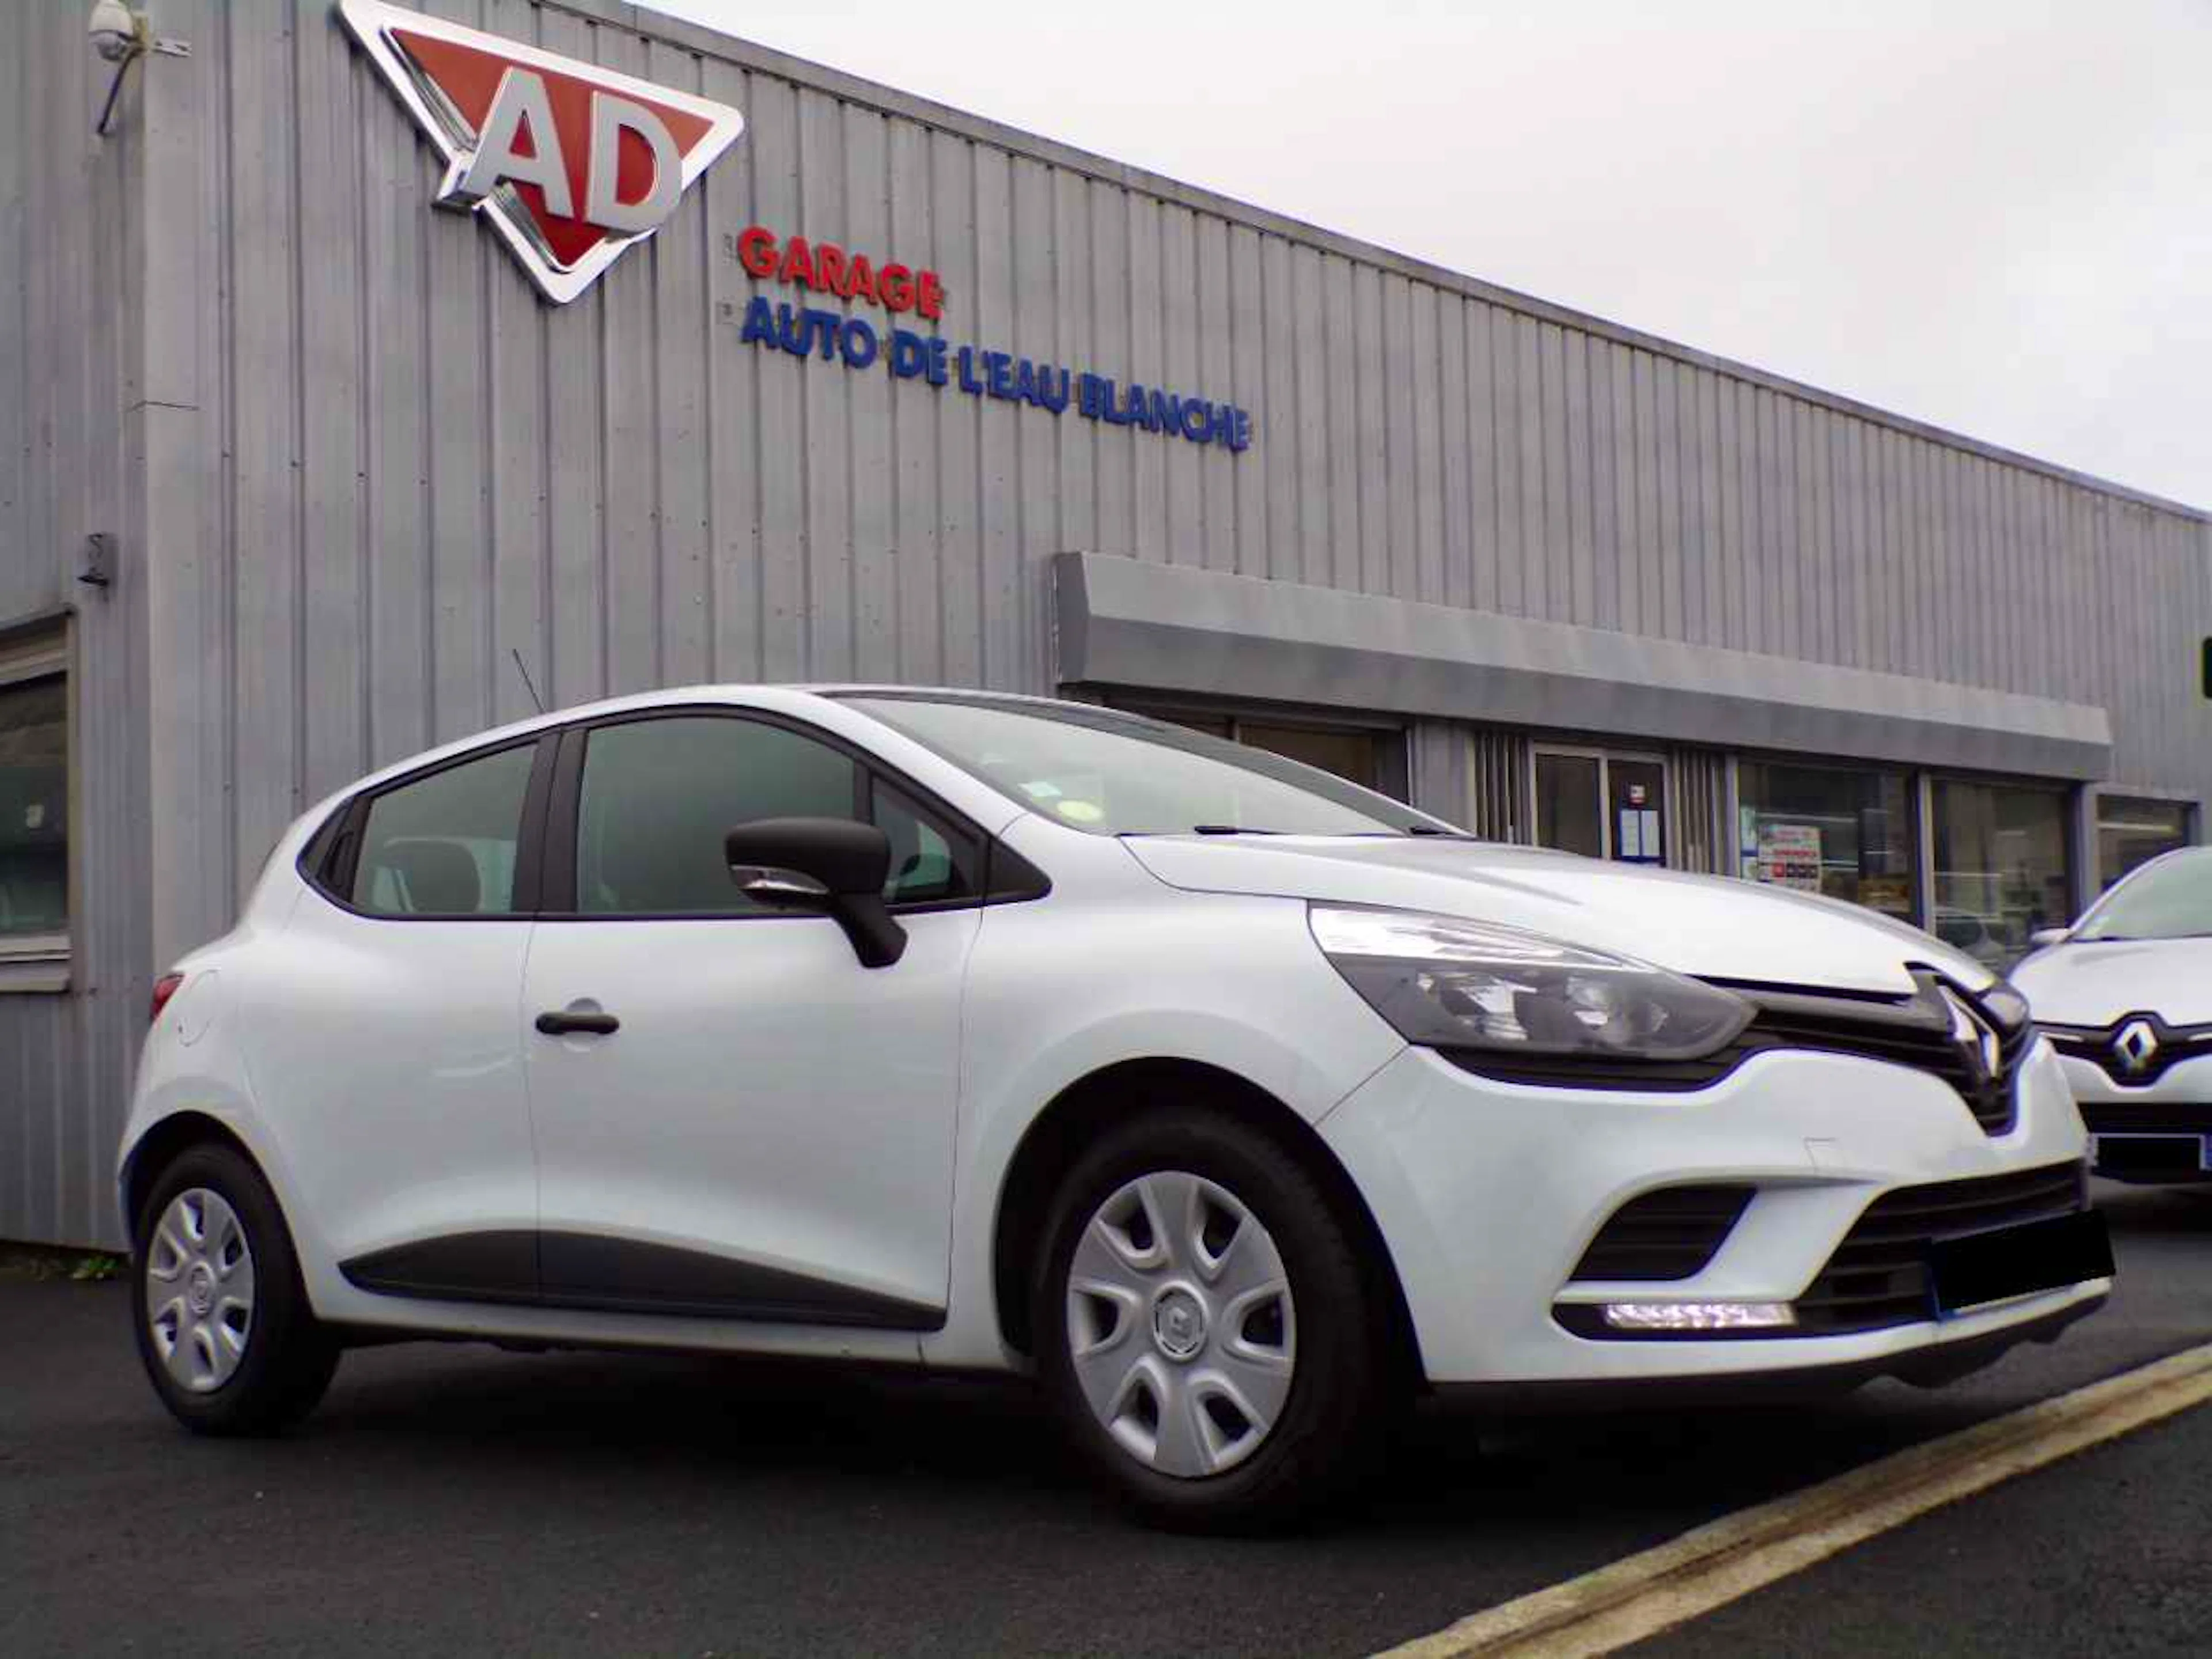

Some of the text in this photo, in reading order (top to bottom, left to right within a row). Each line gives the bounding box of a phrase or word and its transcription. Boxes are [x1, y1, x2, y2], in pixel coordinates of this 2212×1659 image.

[460, 54, 683, 233] AD
[738, 226, 945, 320] GARAGE
[741, 295, 1251, 452] AUTO DE L'EAU BLANCHE
